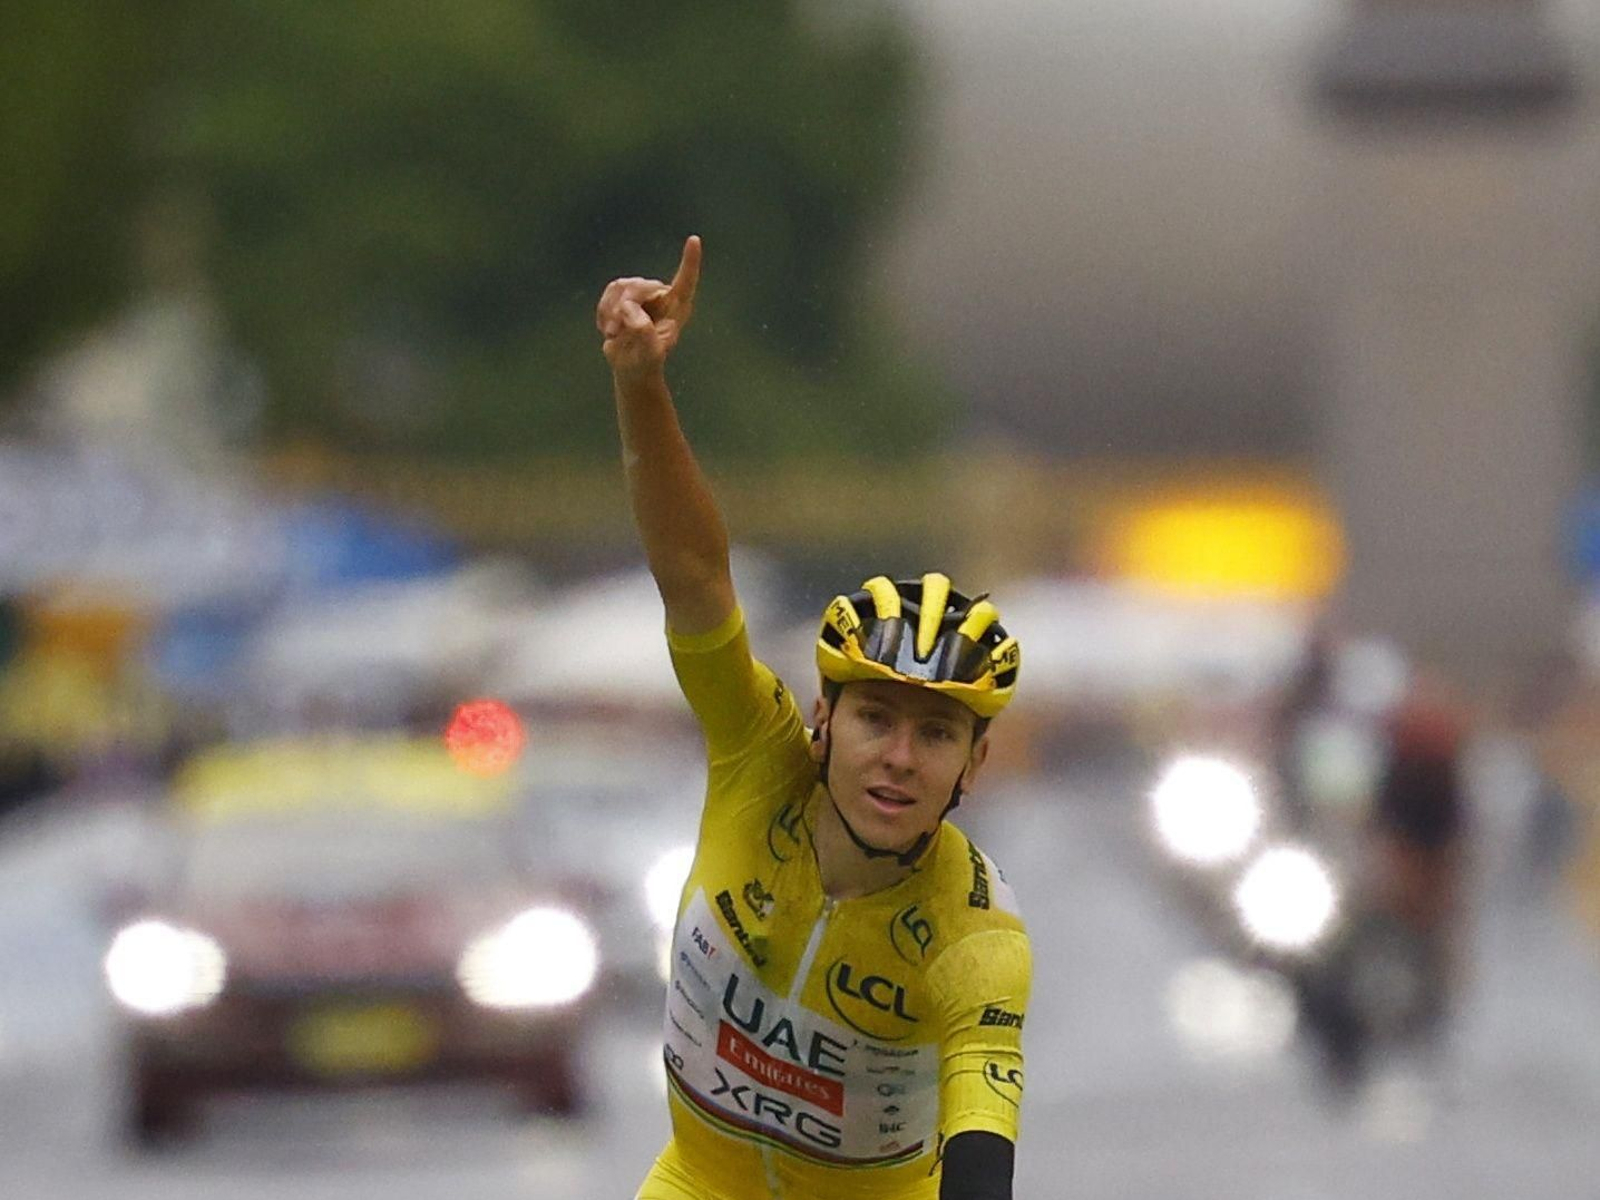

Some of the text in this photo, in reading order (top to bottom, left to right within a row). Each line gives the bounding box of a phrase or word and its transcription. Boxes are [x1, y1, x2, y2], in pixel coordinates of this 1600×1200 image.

[723, 973, 848, 1077] UAE
[837, 963, 920, 1022] LCL
[729, 1036, 831, 1100] Emirates
[711, 1066, 842, 1149] XRG
